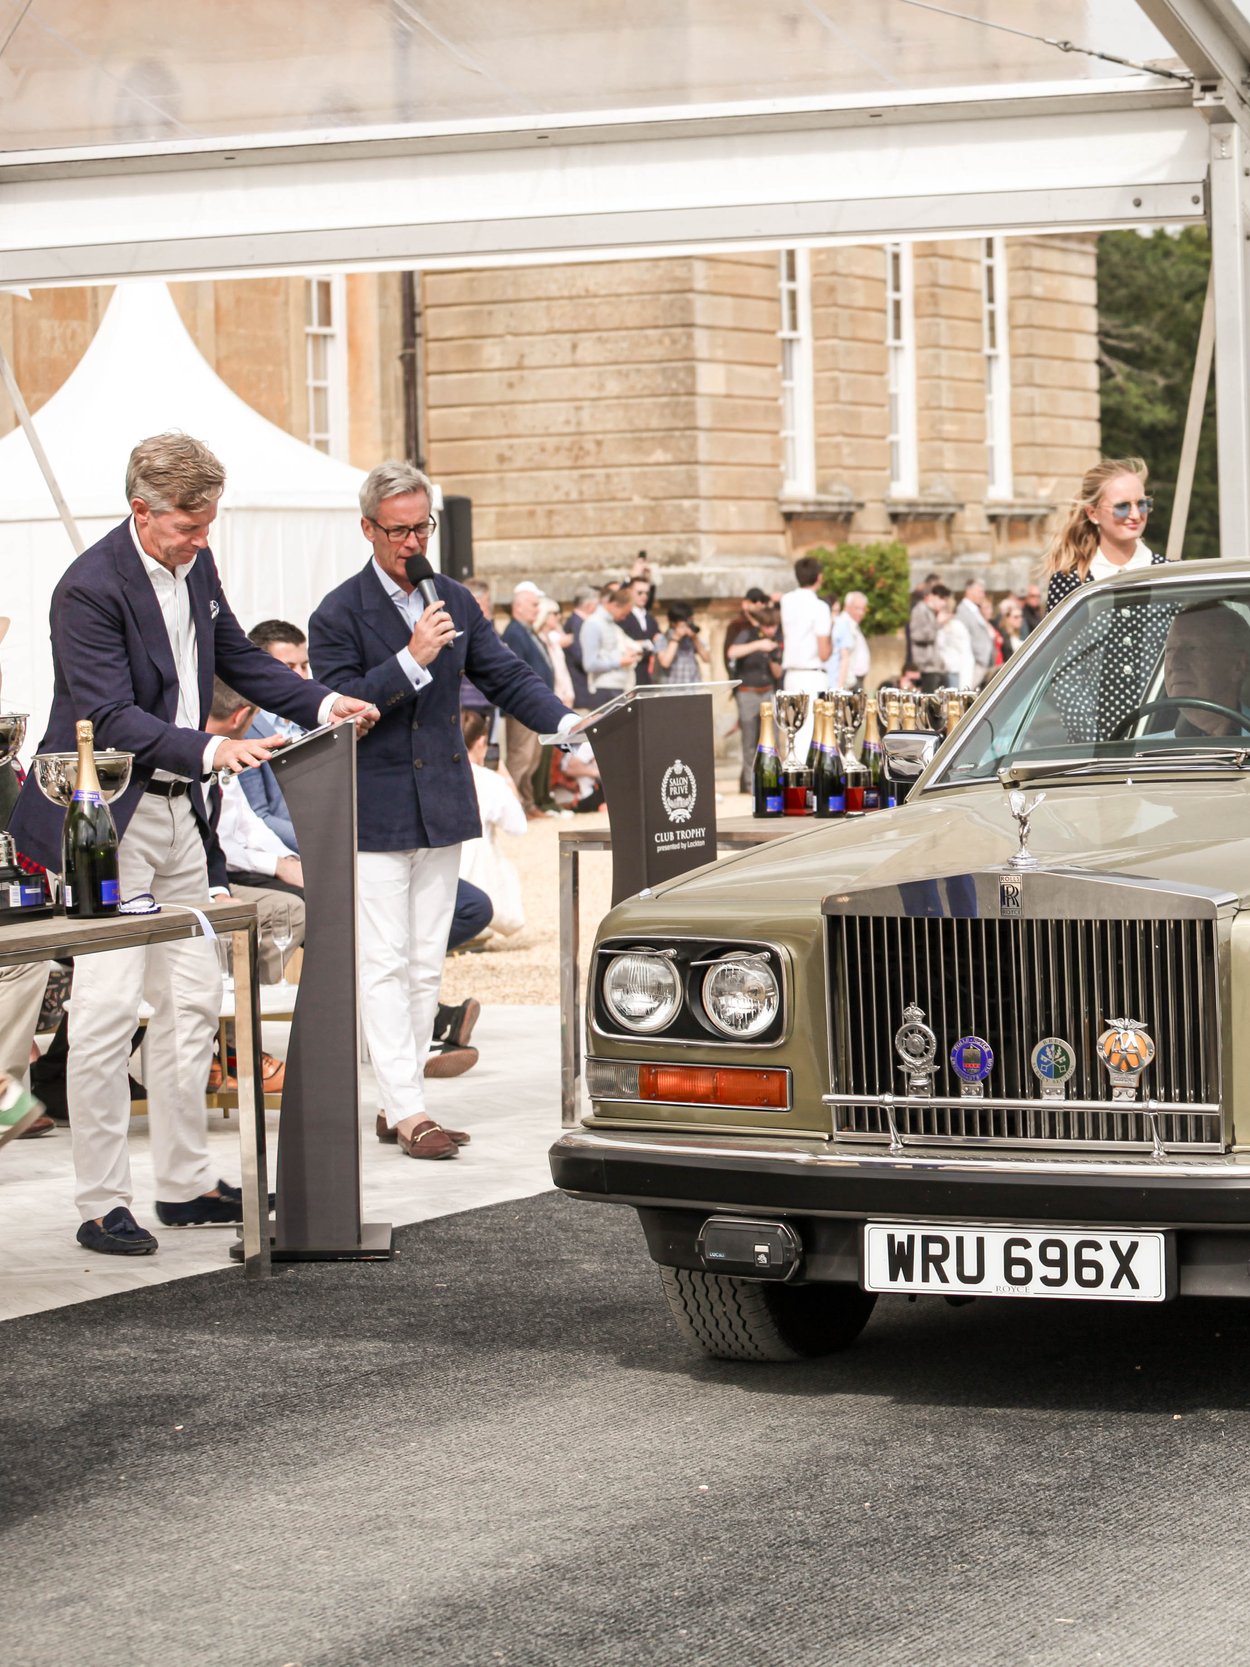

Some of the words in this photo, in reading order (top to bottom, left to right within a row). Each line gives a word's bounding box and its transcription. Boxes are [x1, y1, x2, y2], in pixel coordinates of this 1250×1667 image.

[669, 777, 689, 786] SALON
[654, 832, 674, 843] CLUB
[675, 827, 706, 841] TROPHY
[656, 843, 680, 853] presented
[681, 842, 687, 850] by
[687, 840, 705, 848] Lockton
[887, 1233, 985, 1285] WRU
[1003, 1237, 1140, 1290] 696X
